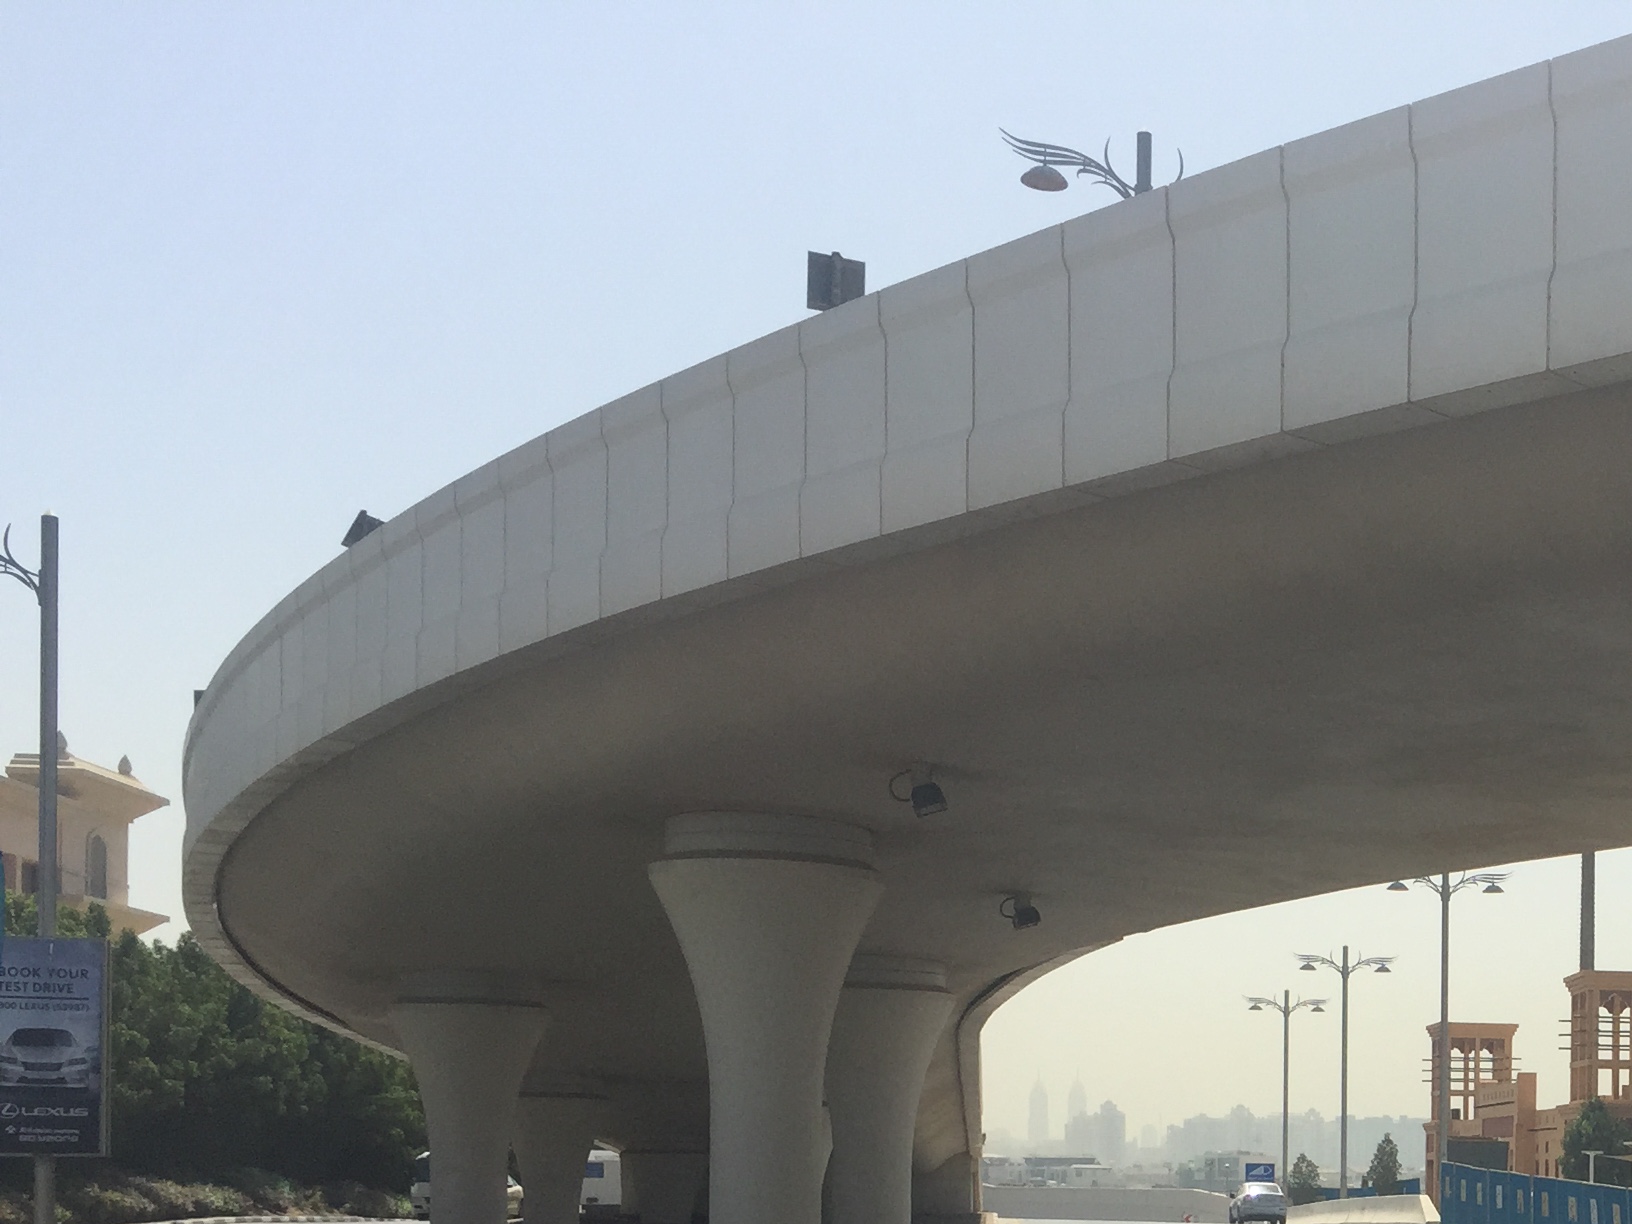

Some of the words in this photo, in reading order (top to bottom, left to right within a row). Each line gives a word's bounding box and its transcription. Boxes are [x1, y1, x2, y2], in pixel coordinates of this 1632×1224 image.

[0, 966, 41, 979] BOOK
[47, 967, 89, 980] YOUR
[0, 981, 29, 993] TEST
[33, 982, 74, 994] DRIVE
[21, 1106, 89, 1117] LEXUS
